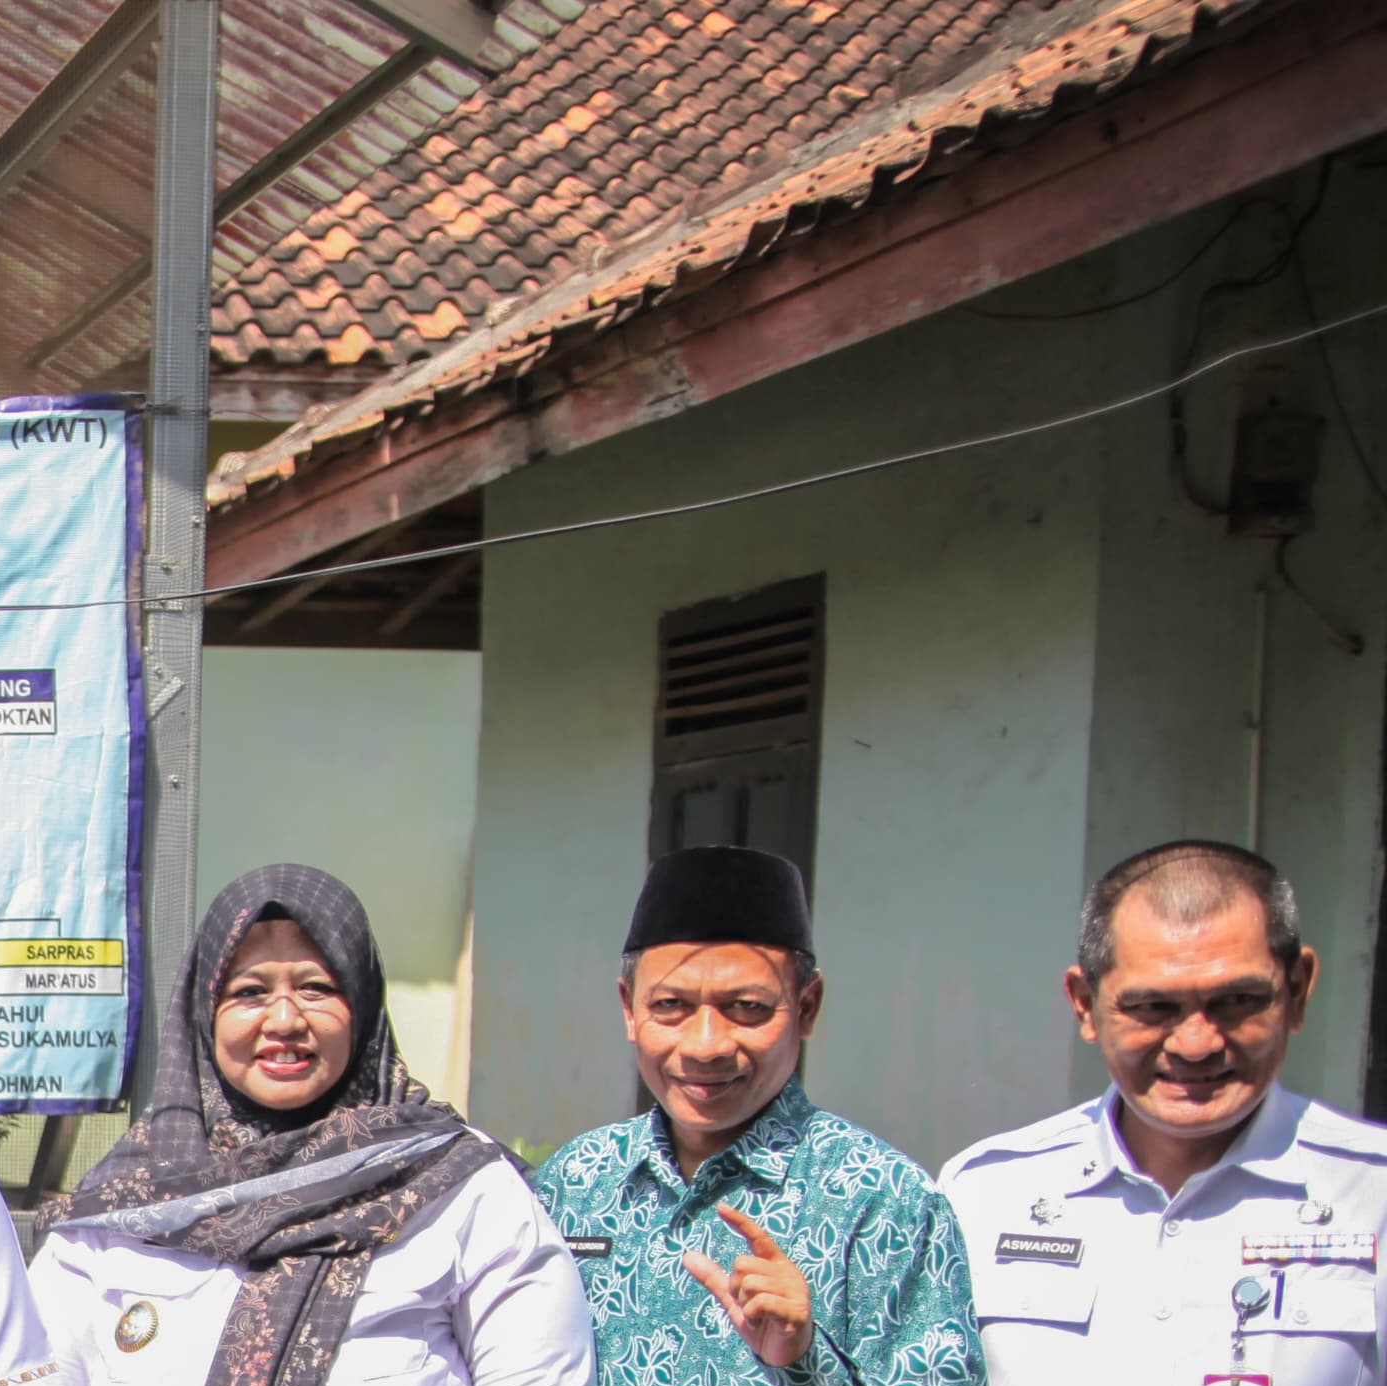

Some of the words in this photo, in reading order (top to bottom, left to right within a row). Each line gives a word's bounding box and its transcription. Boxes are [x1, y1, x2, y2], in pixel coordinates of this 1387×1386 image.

[10, 416, 109, 450] (KWT)
[25, 943, 97, 961] SARPRAS
[1000, 1239, 1075, 1254] ASWARODI
